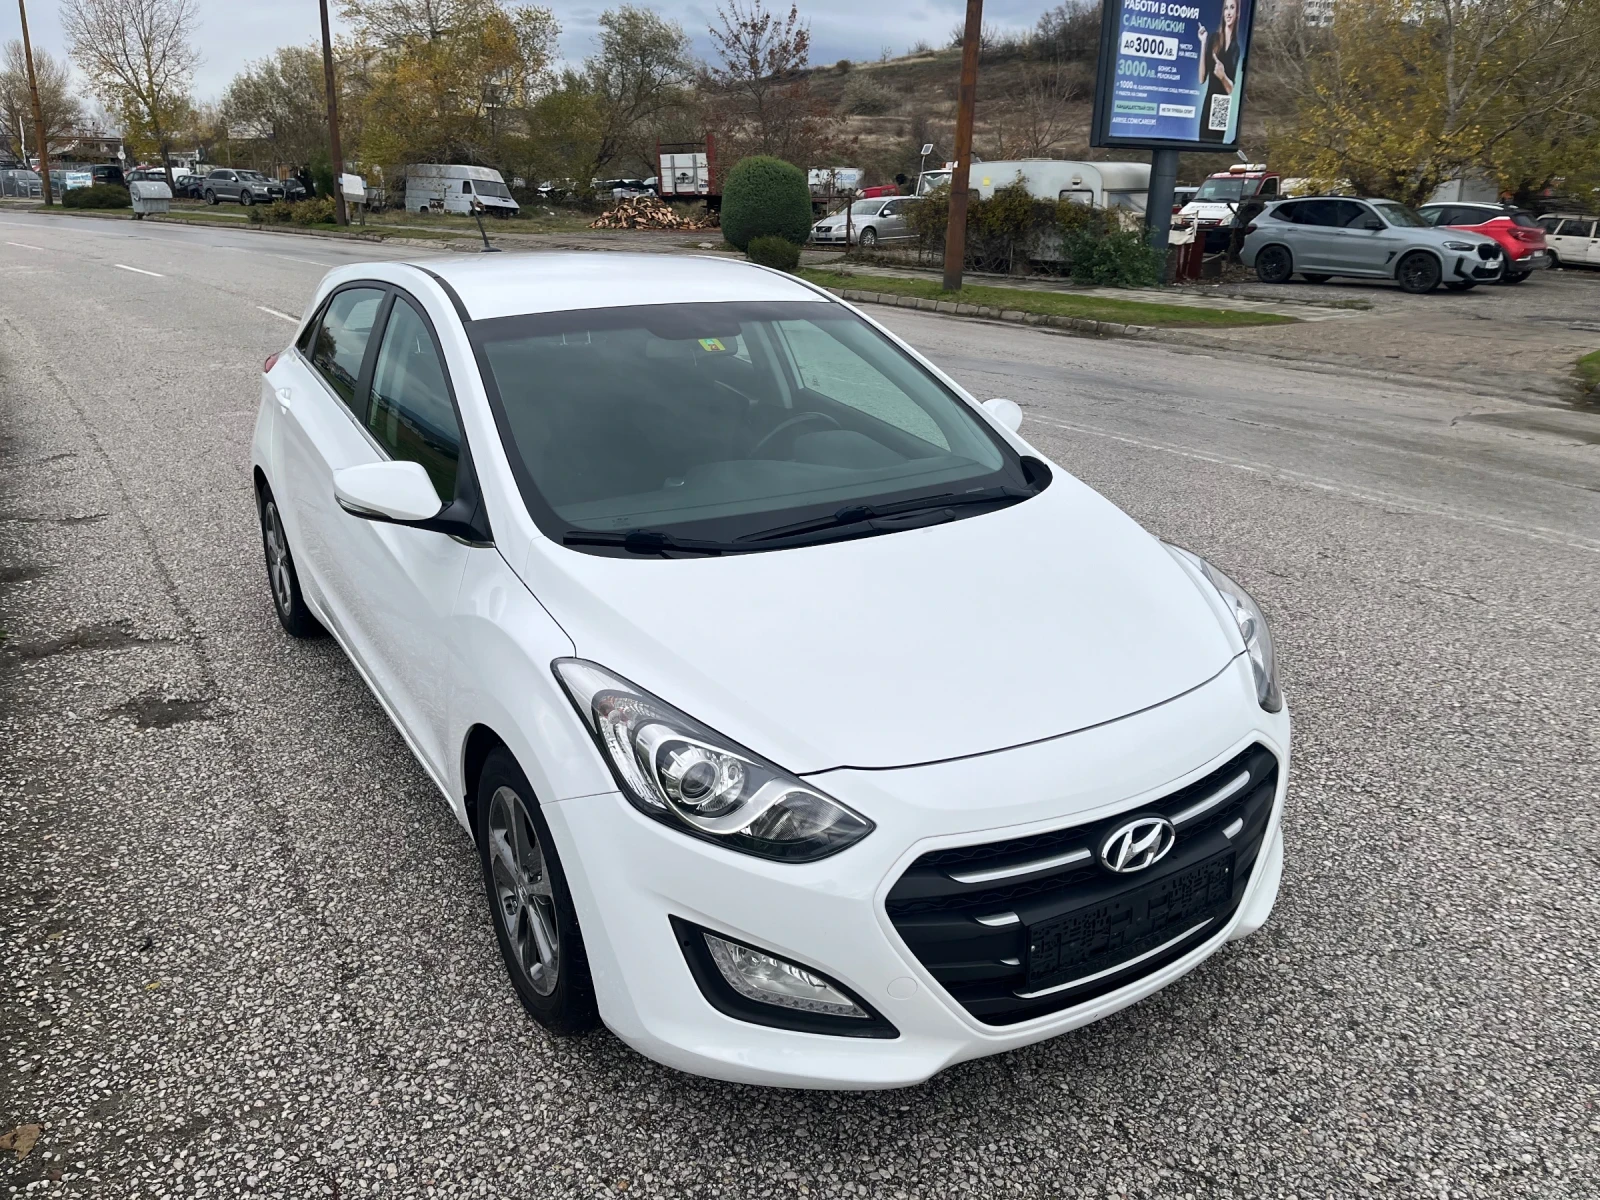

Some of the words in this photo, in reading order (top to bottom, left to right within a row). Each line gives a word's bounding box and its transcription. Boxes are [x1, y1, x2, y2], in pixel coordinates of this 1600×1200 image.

[1124, 0, 1158, 13] РАБОТИ
[1160, 3, 1166, 14] В
[1168, 4, 1199, 19] СОФИЯ
[1123, 14, 1129, 25] С
[1130, 15, 1185, 33] АНГЛИЙСКИ!
[1135, 37, 1164, 55] 3000
[1118, 59, 1147, 76] 3000
